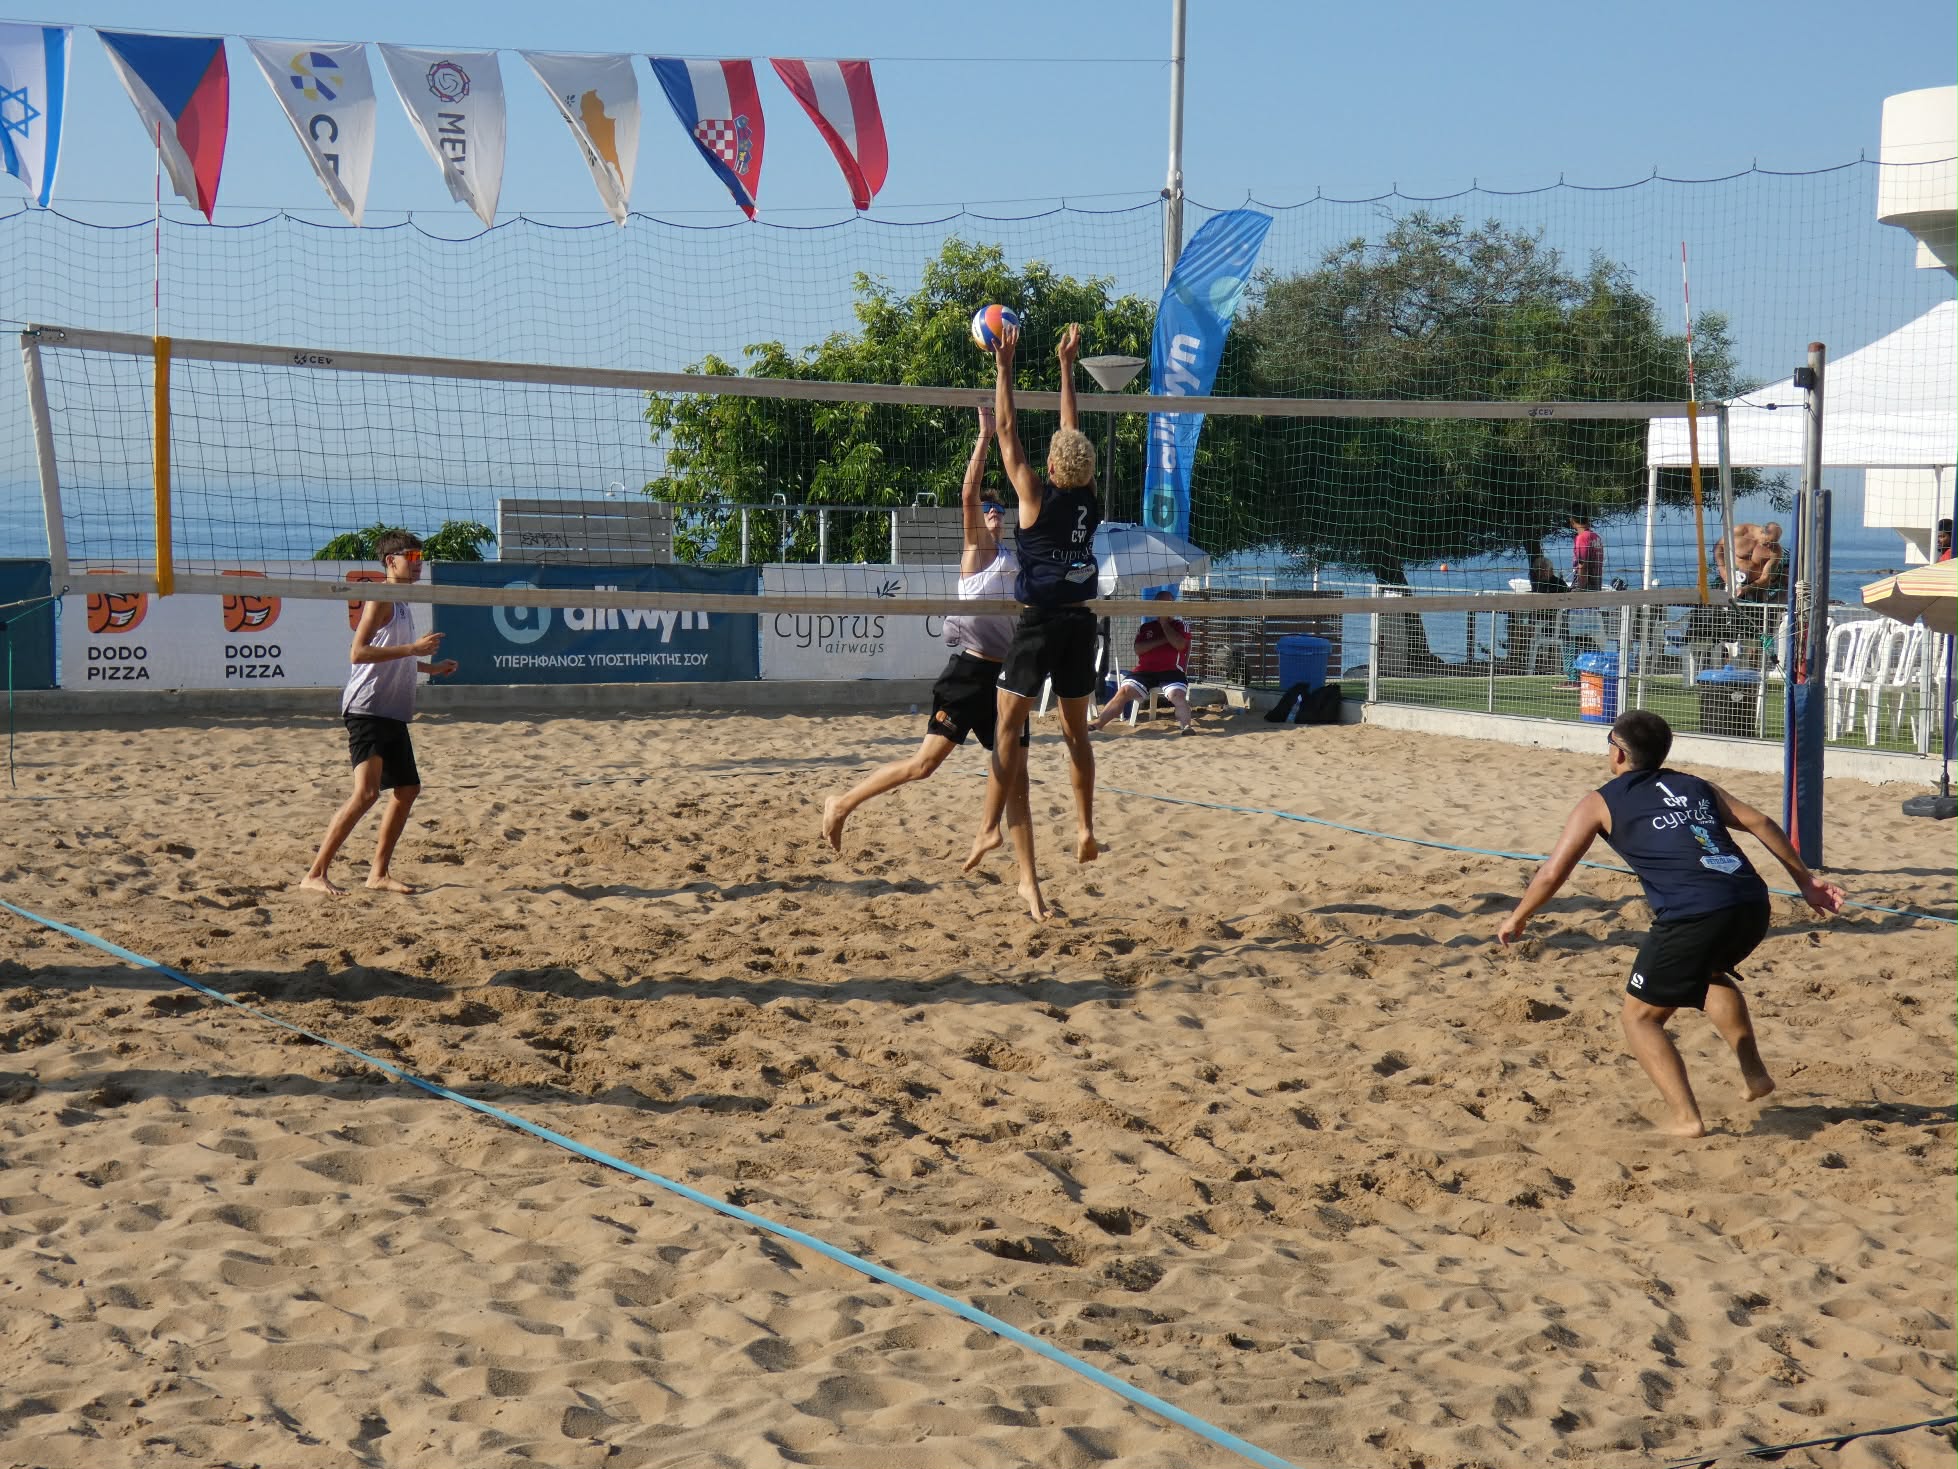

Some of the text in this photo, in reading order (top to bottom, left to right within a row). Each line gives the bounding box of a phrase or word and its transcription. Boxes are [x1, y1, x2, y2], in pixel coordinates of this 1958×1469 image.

[309, 355, 333, 365] CEV
[1153, 333, 1201, 474] allyn
[1538, 408, 1554, 417] CEV
[1077, 505, 1088, 530] 2
[87, 646, 147, 660] DODO
[225, 645, 282, 658] DODO
[825, 640, 885, 656] airways
[493, 653, 709, 668] ΥΠΕΡΗΦΑΝΟΣ ΥΠΟΣΤΗΡΙΚΤΗΣ ΣΟΥ
[87, 666, 150, 680] PIZZA
[225, 664, 285, 678] PIZZA
[1655, 781, 1676, 797] 1
[1663, 795, 1688, 808] CYP
